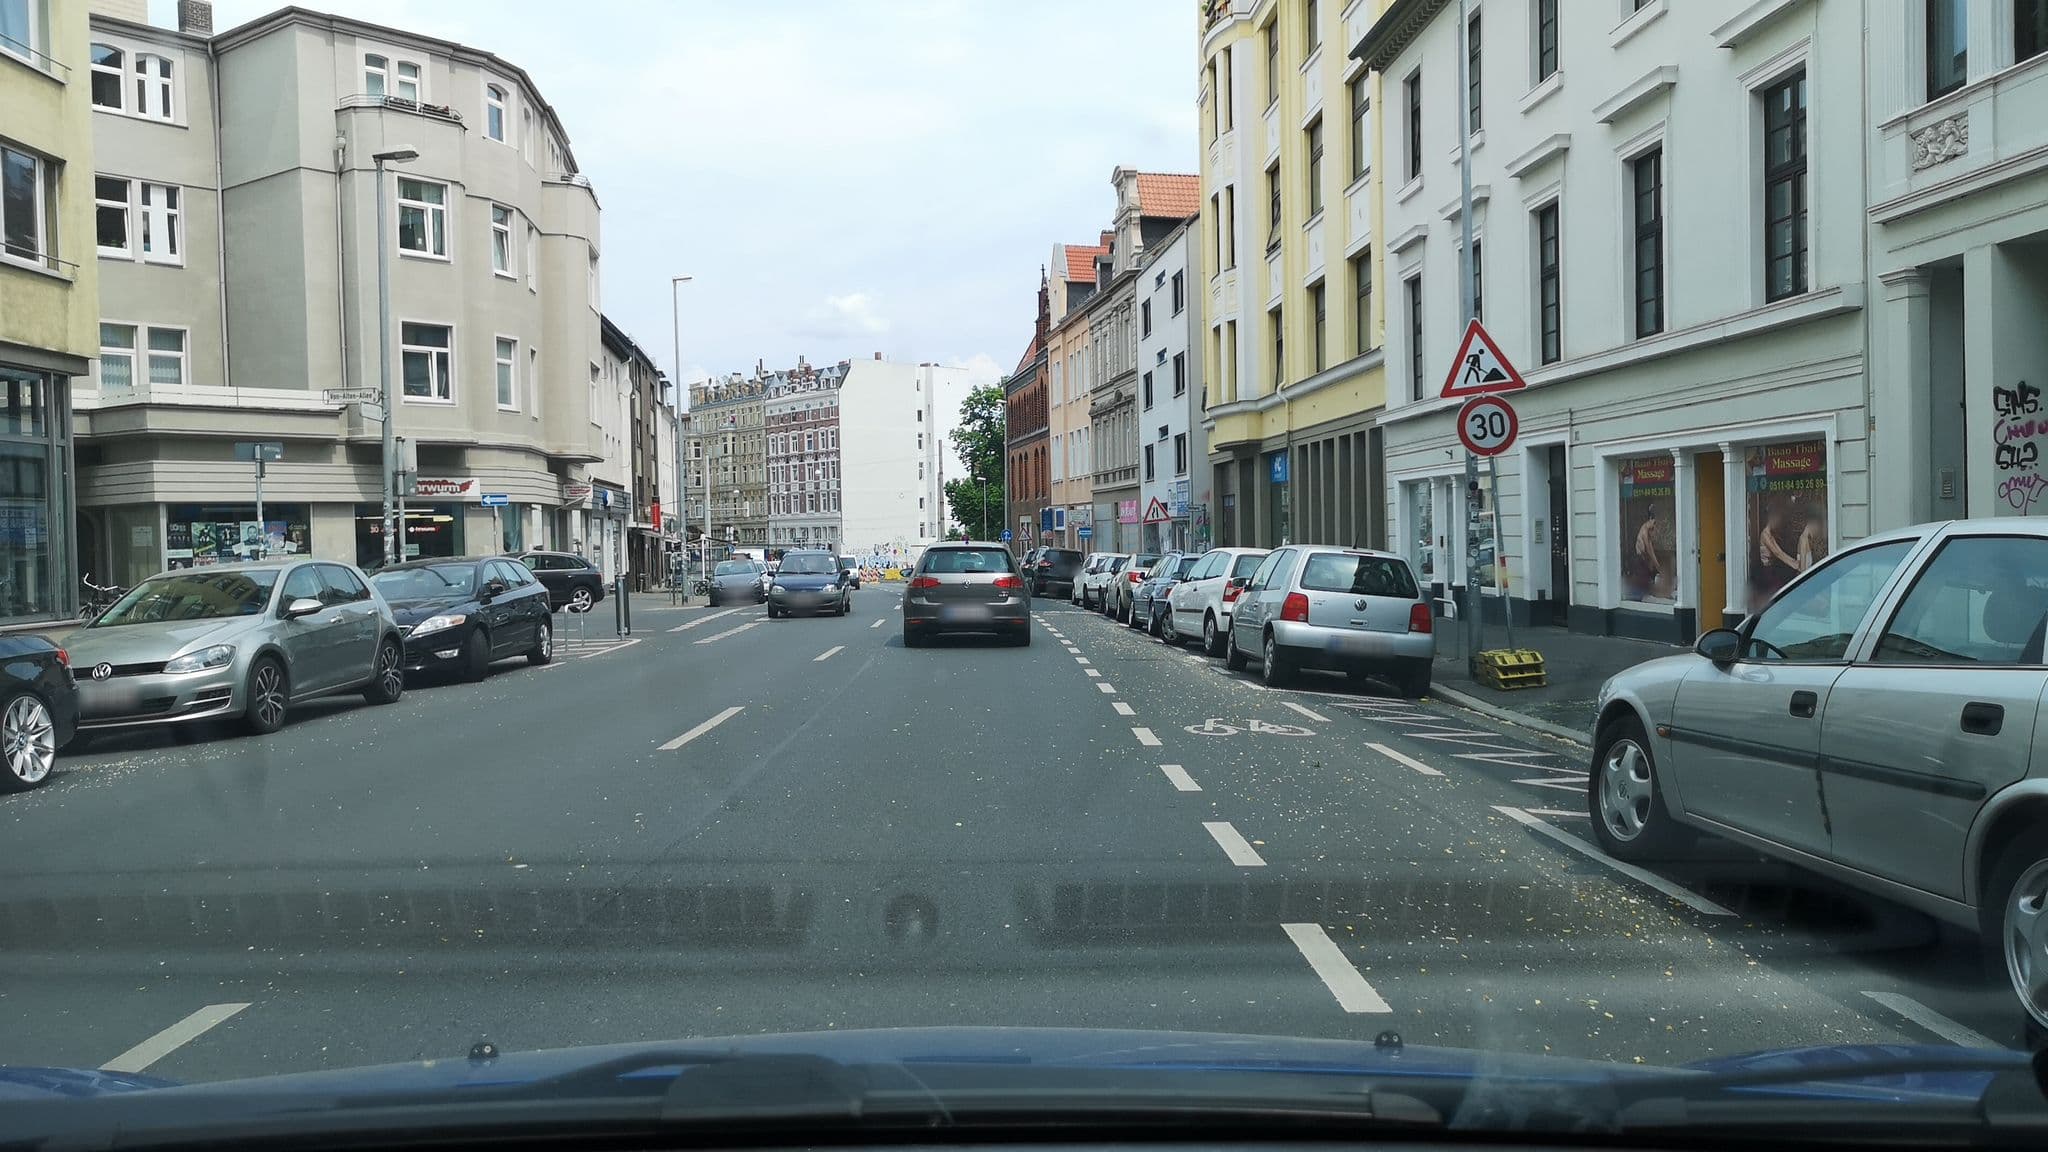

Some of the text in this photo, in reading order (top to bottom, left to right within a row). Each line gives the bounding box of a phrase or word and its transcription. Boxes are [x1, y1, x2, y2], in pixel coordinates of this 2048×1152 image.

[1471, 412, 1505, 440] 30
[1795, 442, 1817, 454] Thai
[1772, 457, 1811, 470] Massage
[1638, 469, 1665, 479] Massage
